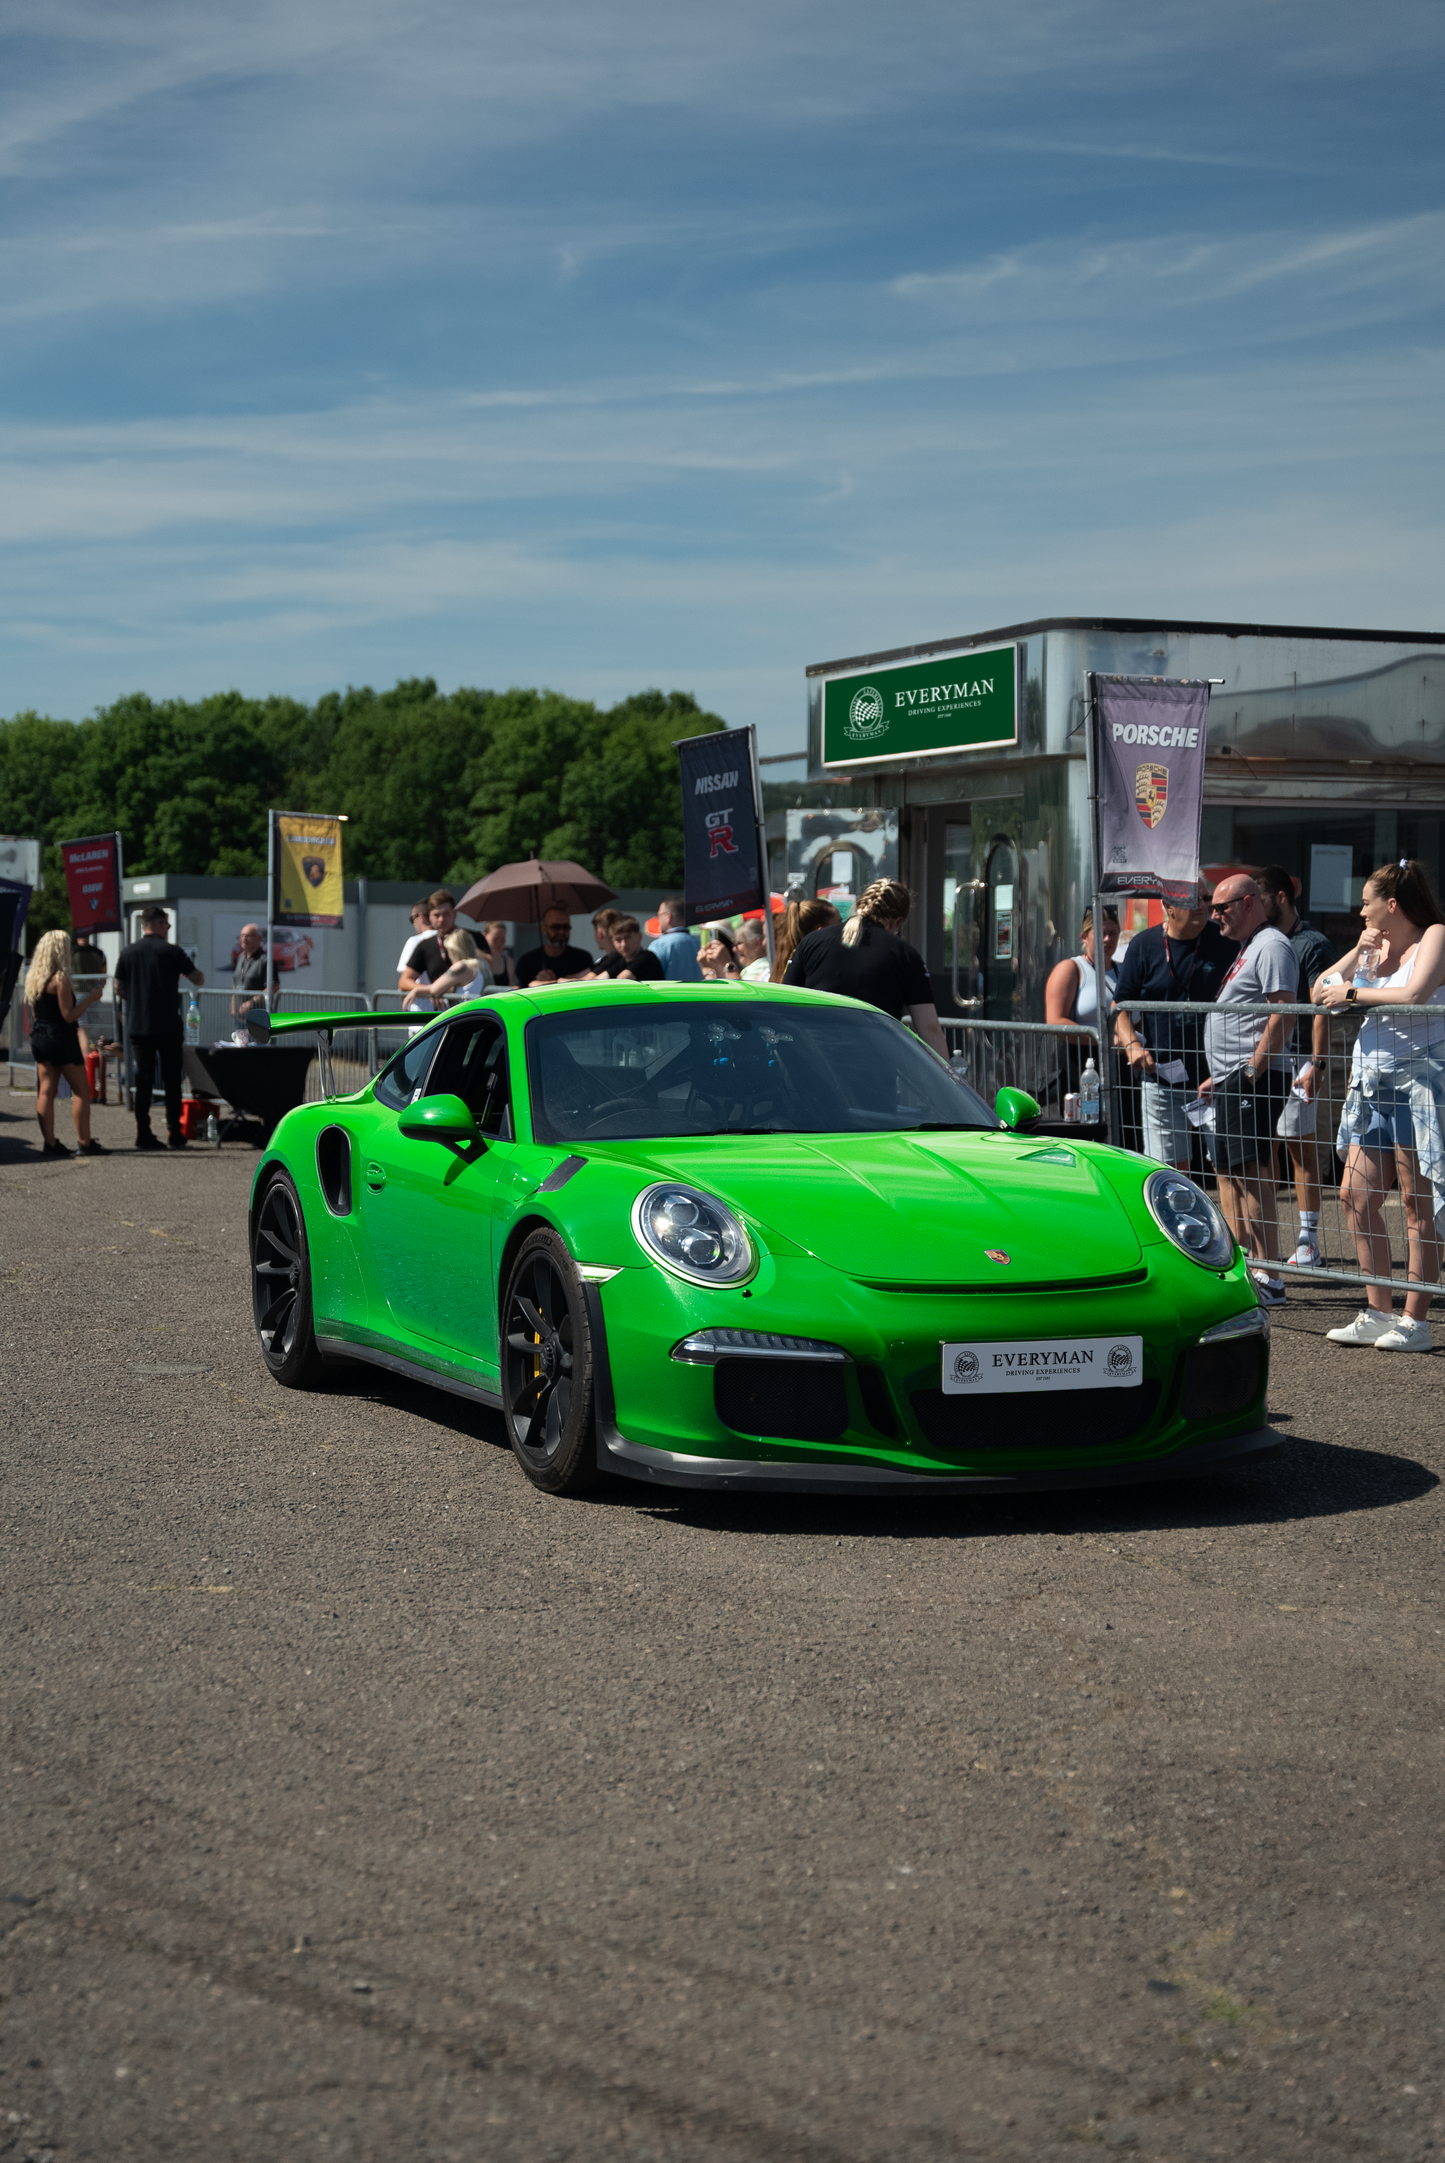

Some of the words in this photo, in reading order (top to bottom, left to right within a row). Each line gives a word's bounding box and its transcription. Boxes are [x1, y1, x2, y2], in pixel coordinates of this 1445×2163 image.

[894, 678, 995, 708] EVERYMAN
[908, 707, 936, 716] DRIVING
[937, 700, 982, 712] EXPERIENCES
[852, 730, 882, 738] EVERYMAN
[1112, 723, 1200, 748] PORSCHE
[695, 770, 739, 795] NISSAN
[705, 808, 733, 828] GT
[709, 825, 739, 858] R
[69, 849, 109, 863] McLAREN
[992, 1350, 1094, 1367] EVERYMAN
[1035, 1367, 1081, 1375] EXPERIENCES
